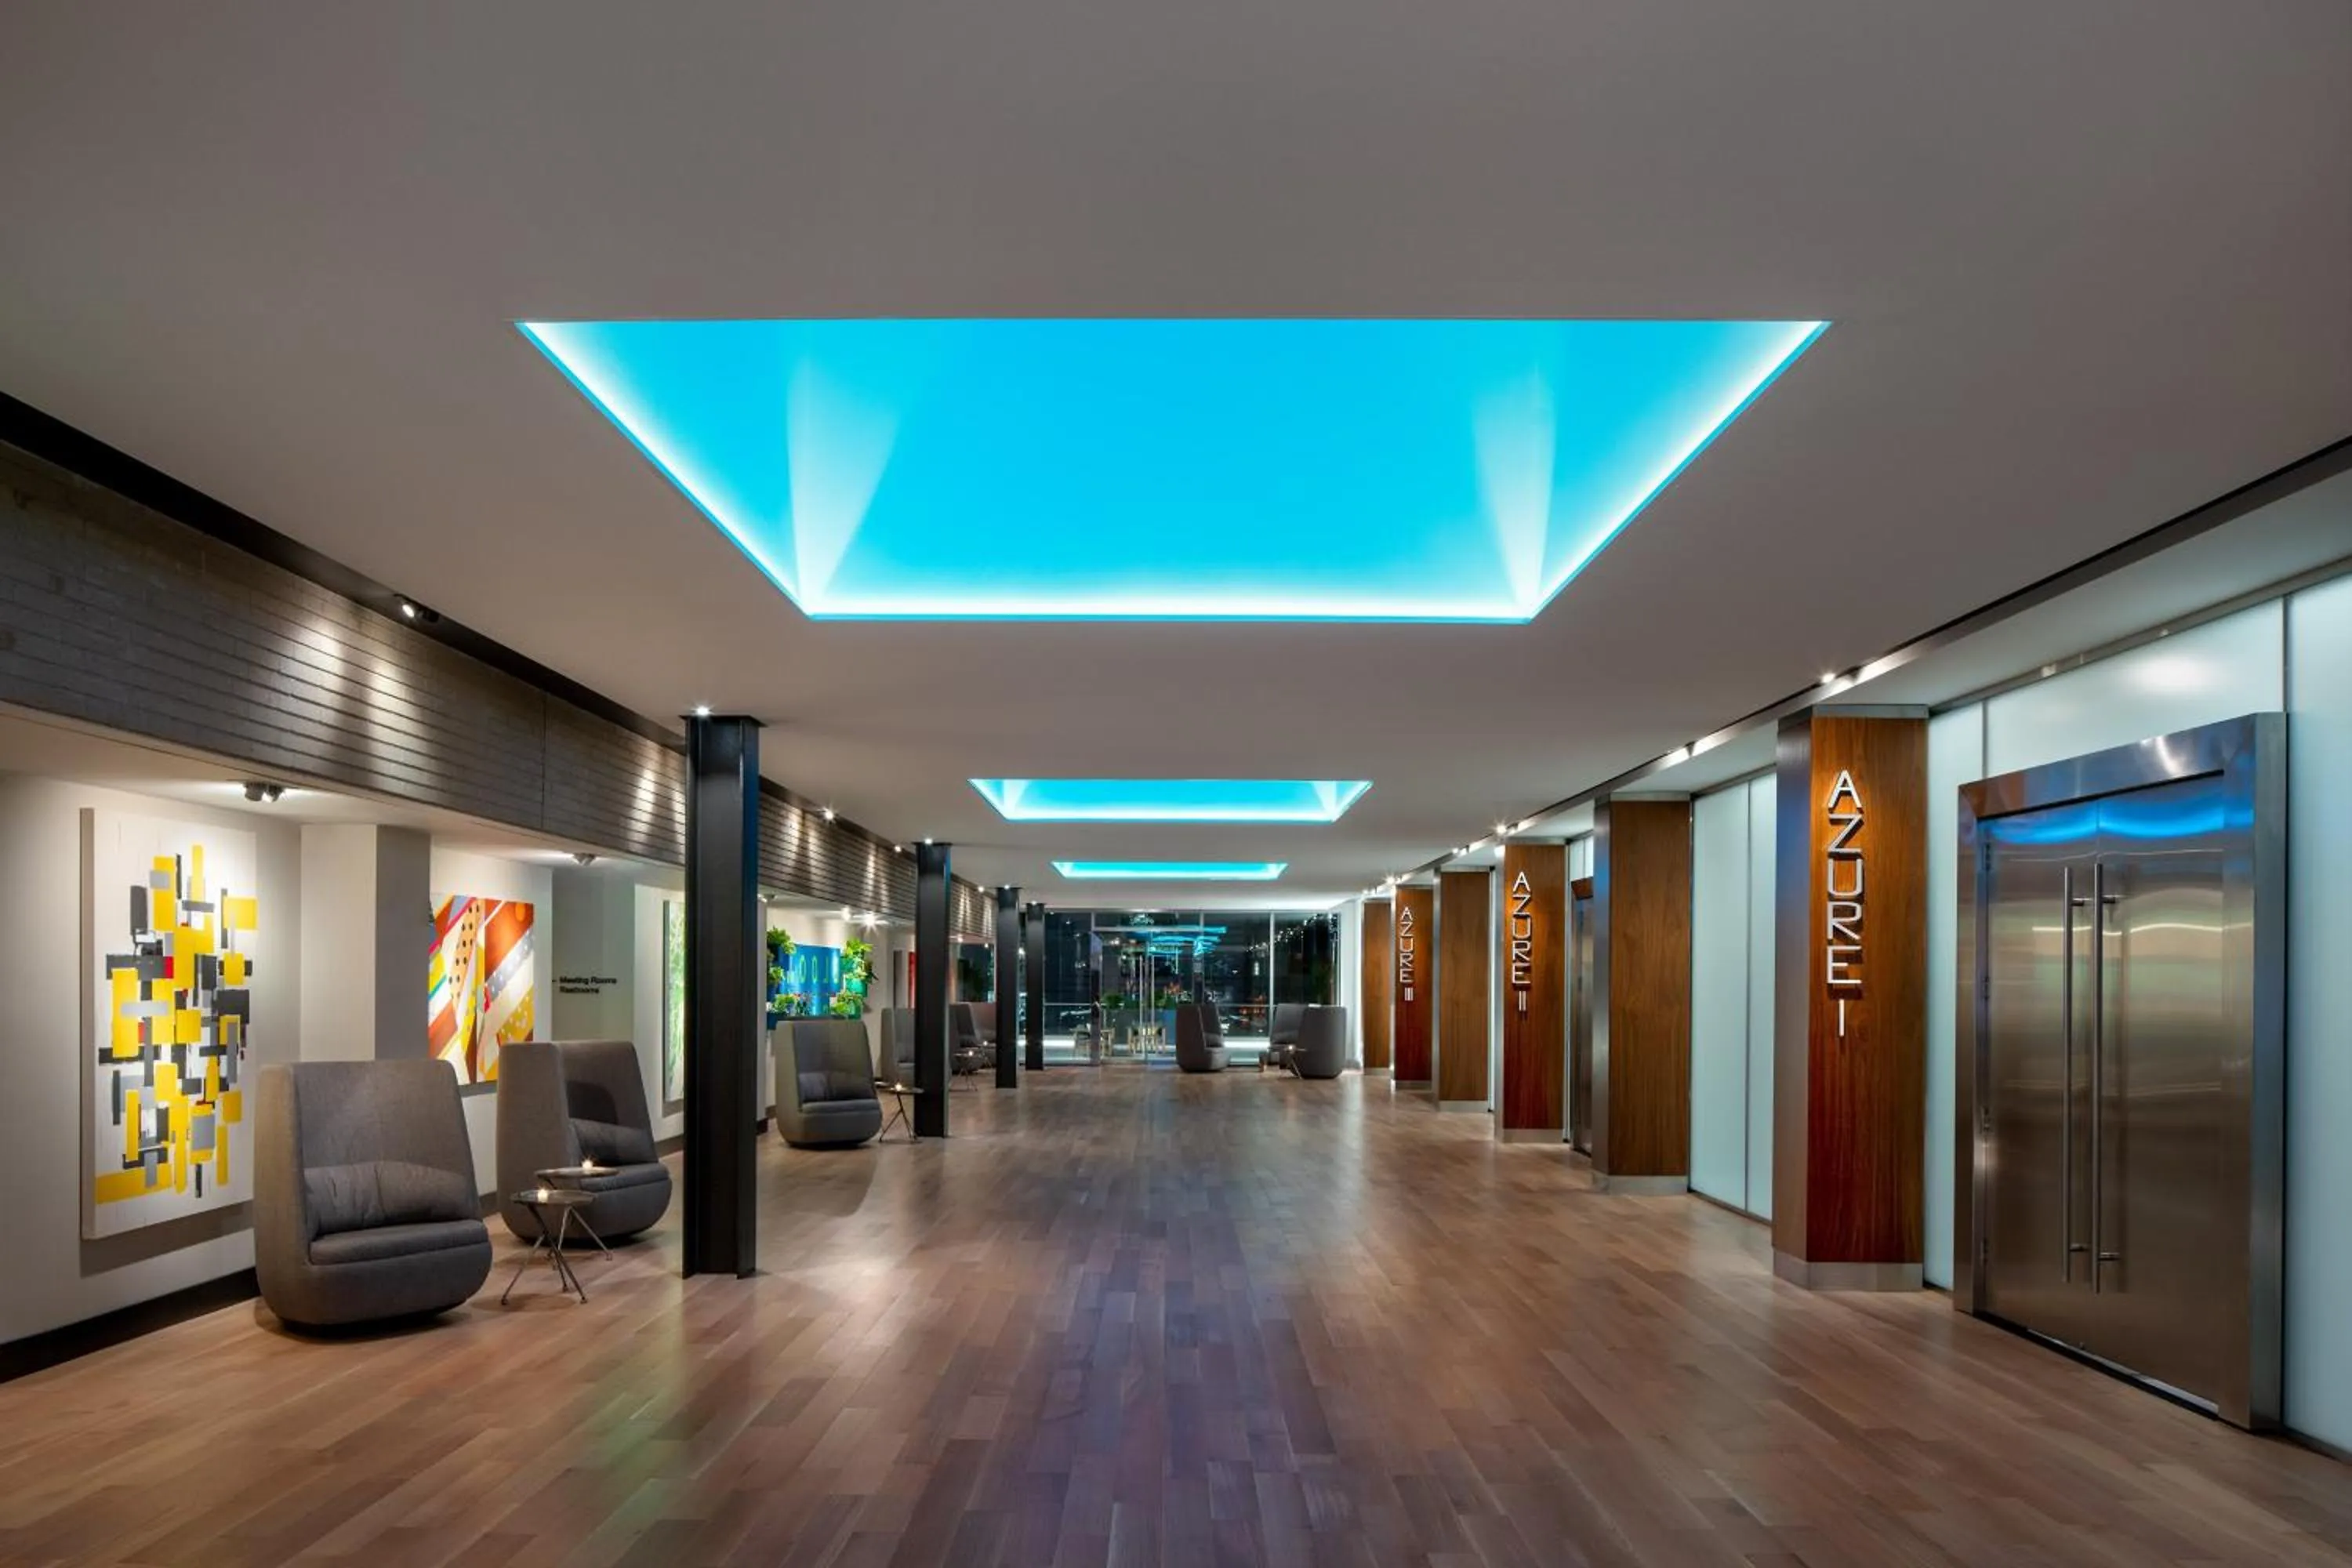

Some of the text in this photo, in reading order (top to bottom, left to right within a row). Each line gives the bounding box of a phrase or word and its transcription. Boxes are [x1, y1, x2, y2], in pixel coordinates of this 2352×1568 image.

[1399, 906, 1414, 1001] AZURE III
[1512, 871, 1531, 1011] AZURE II
[1827, 769, 1863, 1036] AZURE I
